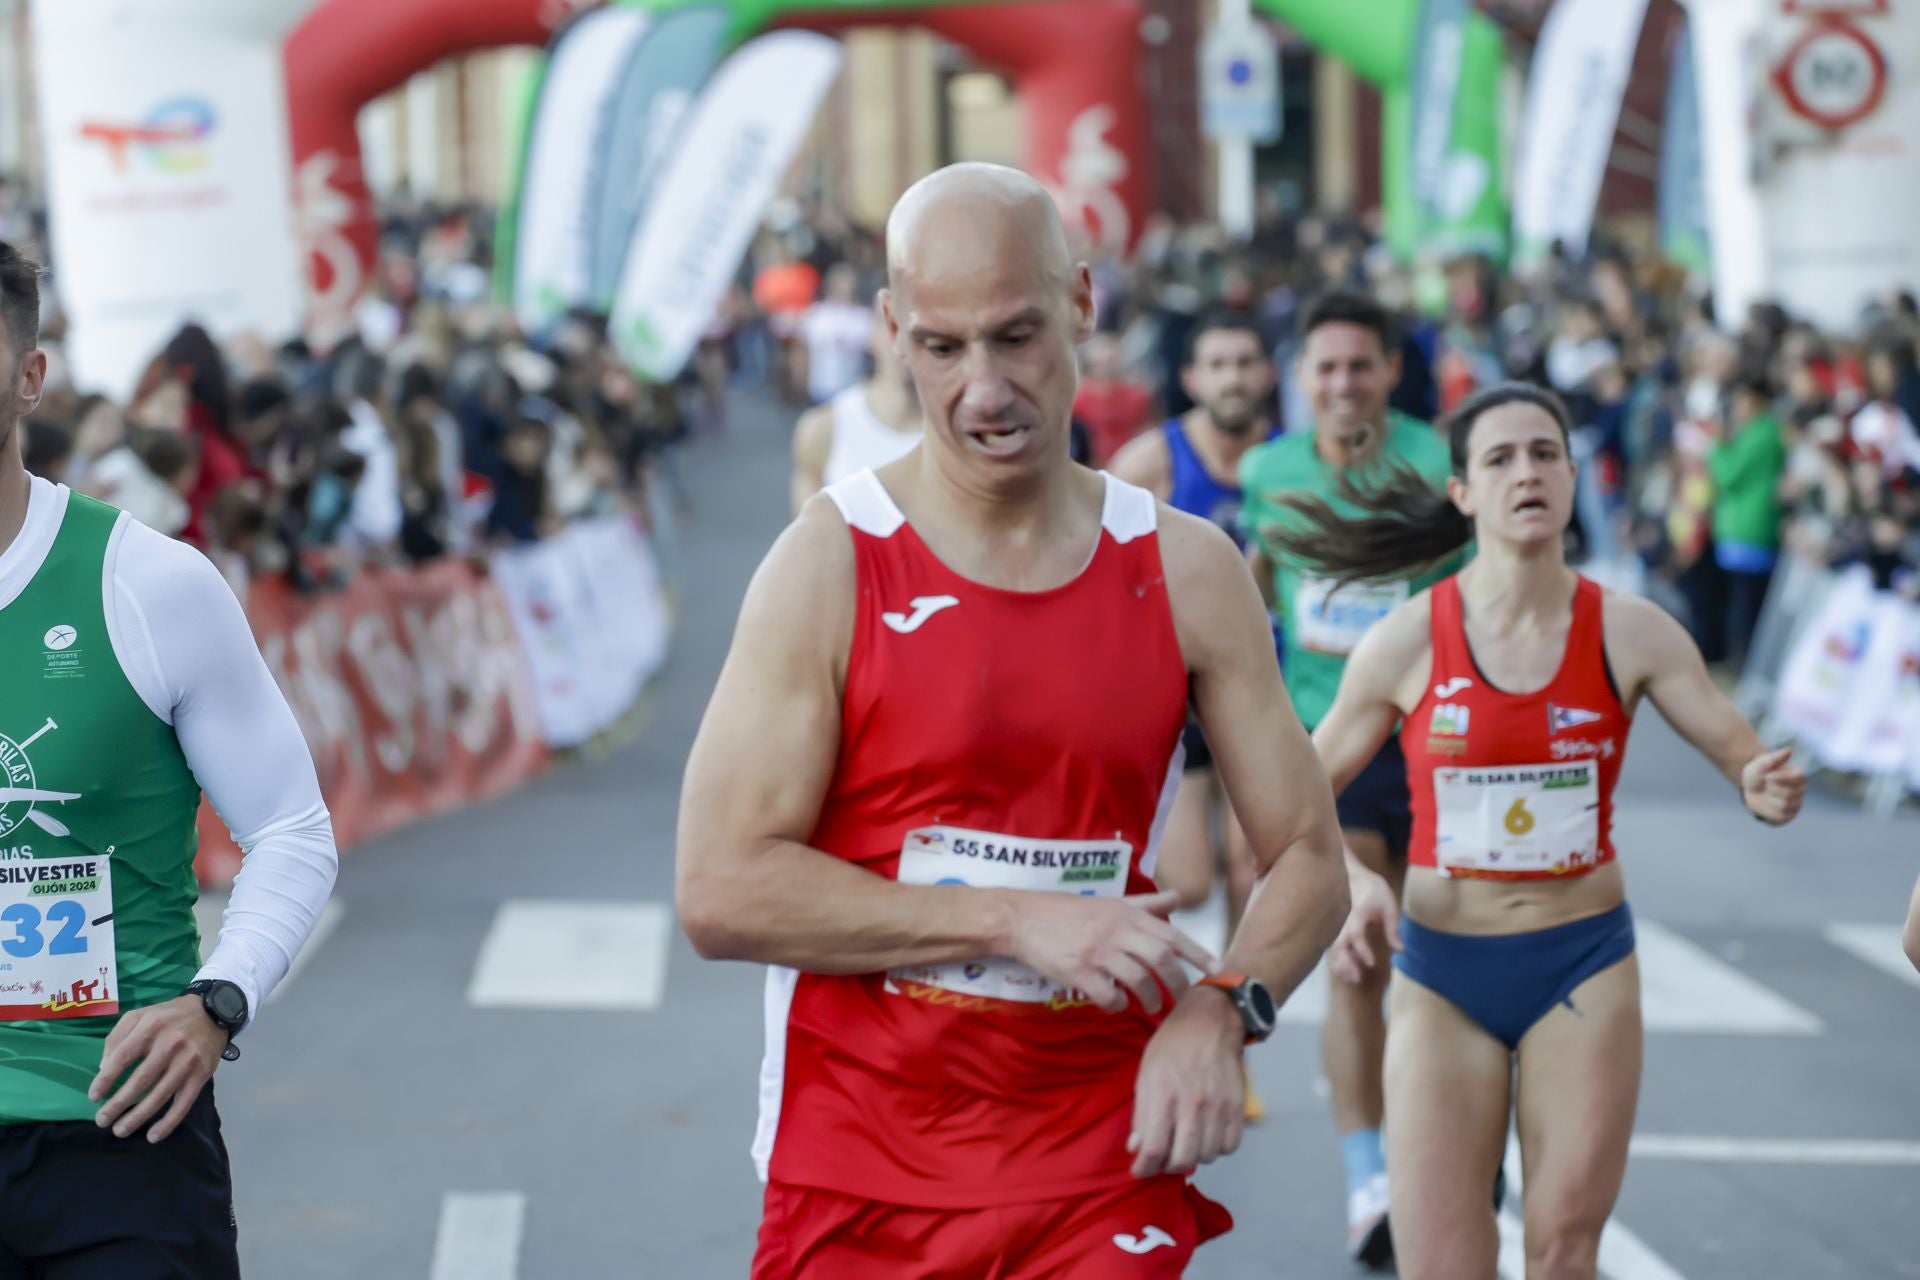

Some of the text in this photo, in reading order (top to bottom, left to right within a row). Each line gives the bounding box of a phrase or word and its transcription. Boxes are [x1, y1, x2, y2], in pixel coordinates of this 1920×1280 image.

[46, 652, 78, 660] DEPORTE
[1504, 796, 1535, 836] 6
[952, 838, 1120, 868] 55 SAN SILVESTRE
[0, 862, 97, 884] SILVESTRE
[33, 880, 97, 895] GIJÓN 2024
[1, 900, 88, 958] 32
